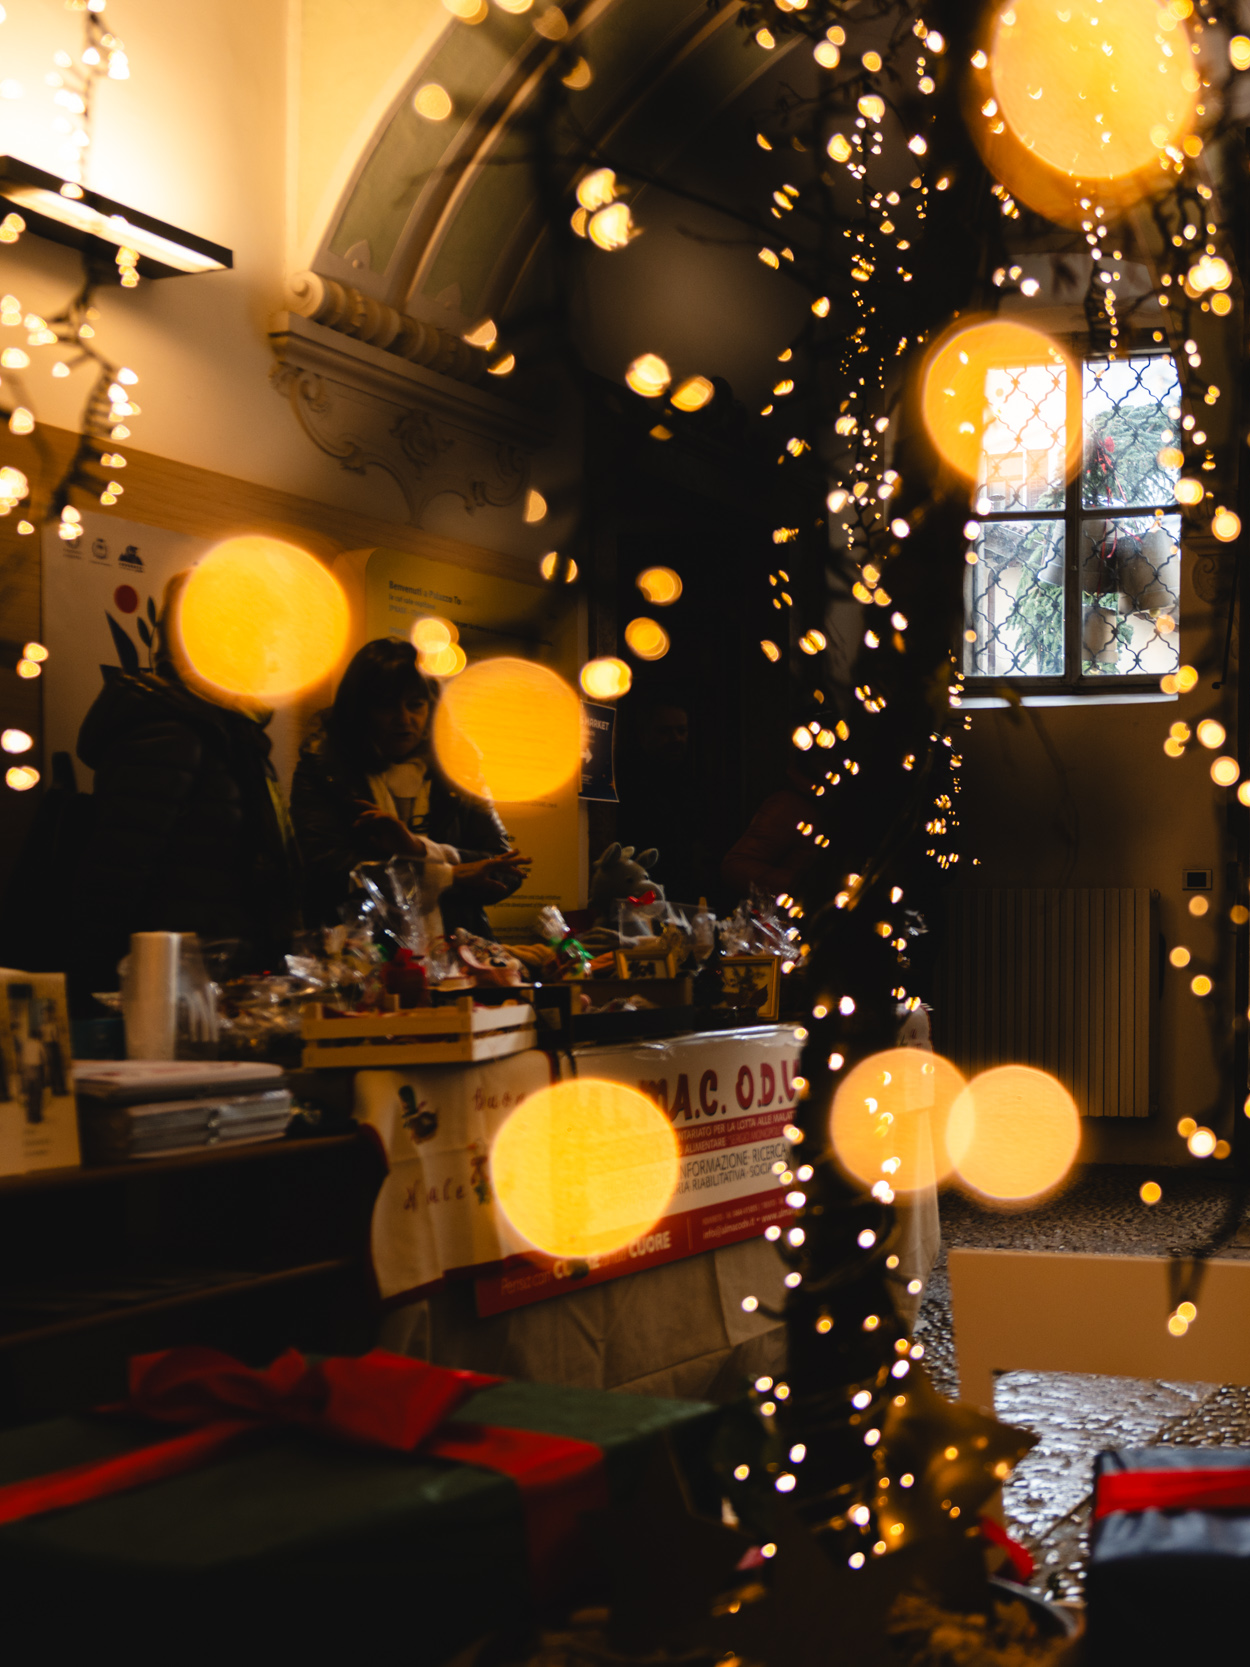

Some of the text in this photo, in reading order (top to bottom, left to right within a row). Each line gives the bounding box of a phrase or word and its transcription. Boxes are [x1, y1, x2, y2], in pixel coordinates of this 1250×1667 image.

[389, 580, 422, 596] Benvenuti
[713, 1123, 725, 1135] PER
[727, 1121, 736, 1132] LA
[737, 1118, 756, 1130] LOTTA
[759, 1114, 772, 1125] ALLE
[684, 1137, 727, 1153] ALIMENTARE
[752, 1142, 786, 1161] RICERCA
[692, 1167, 746, 1191] RIABILITATIVA
[749, 1162, 775, 1178] SOCIA
[628, 1230, 672, 1259] CUORE
